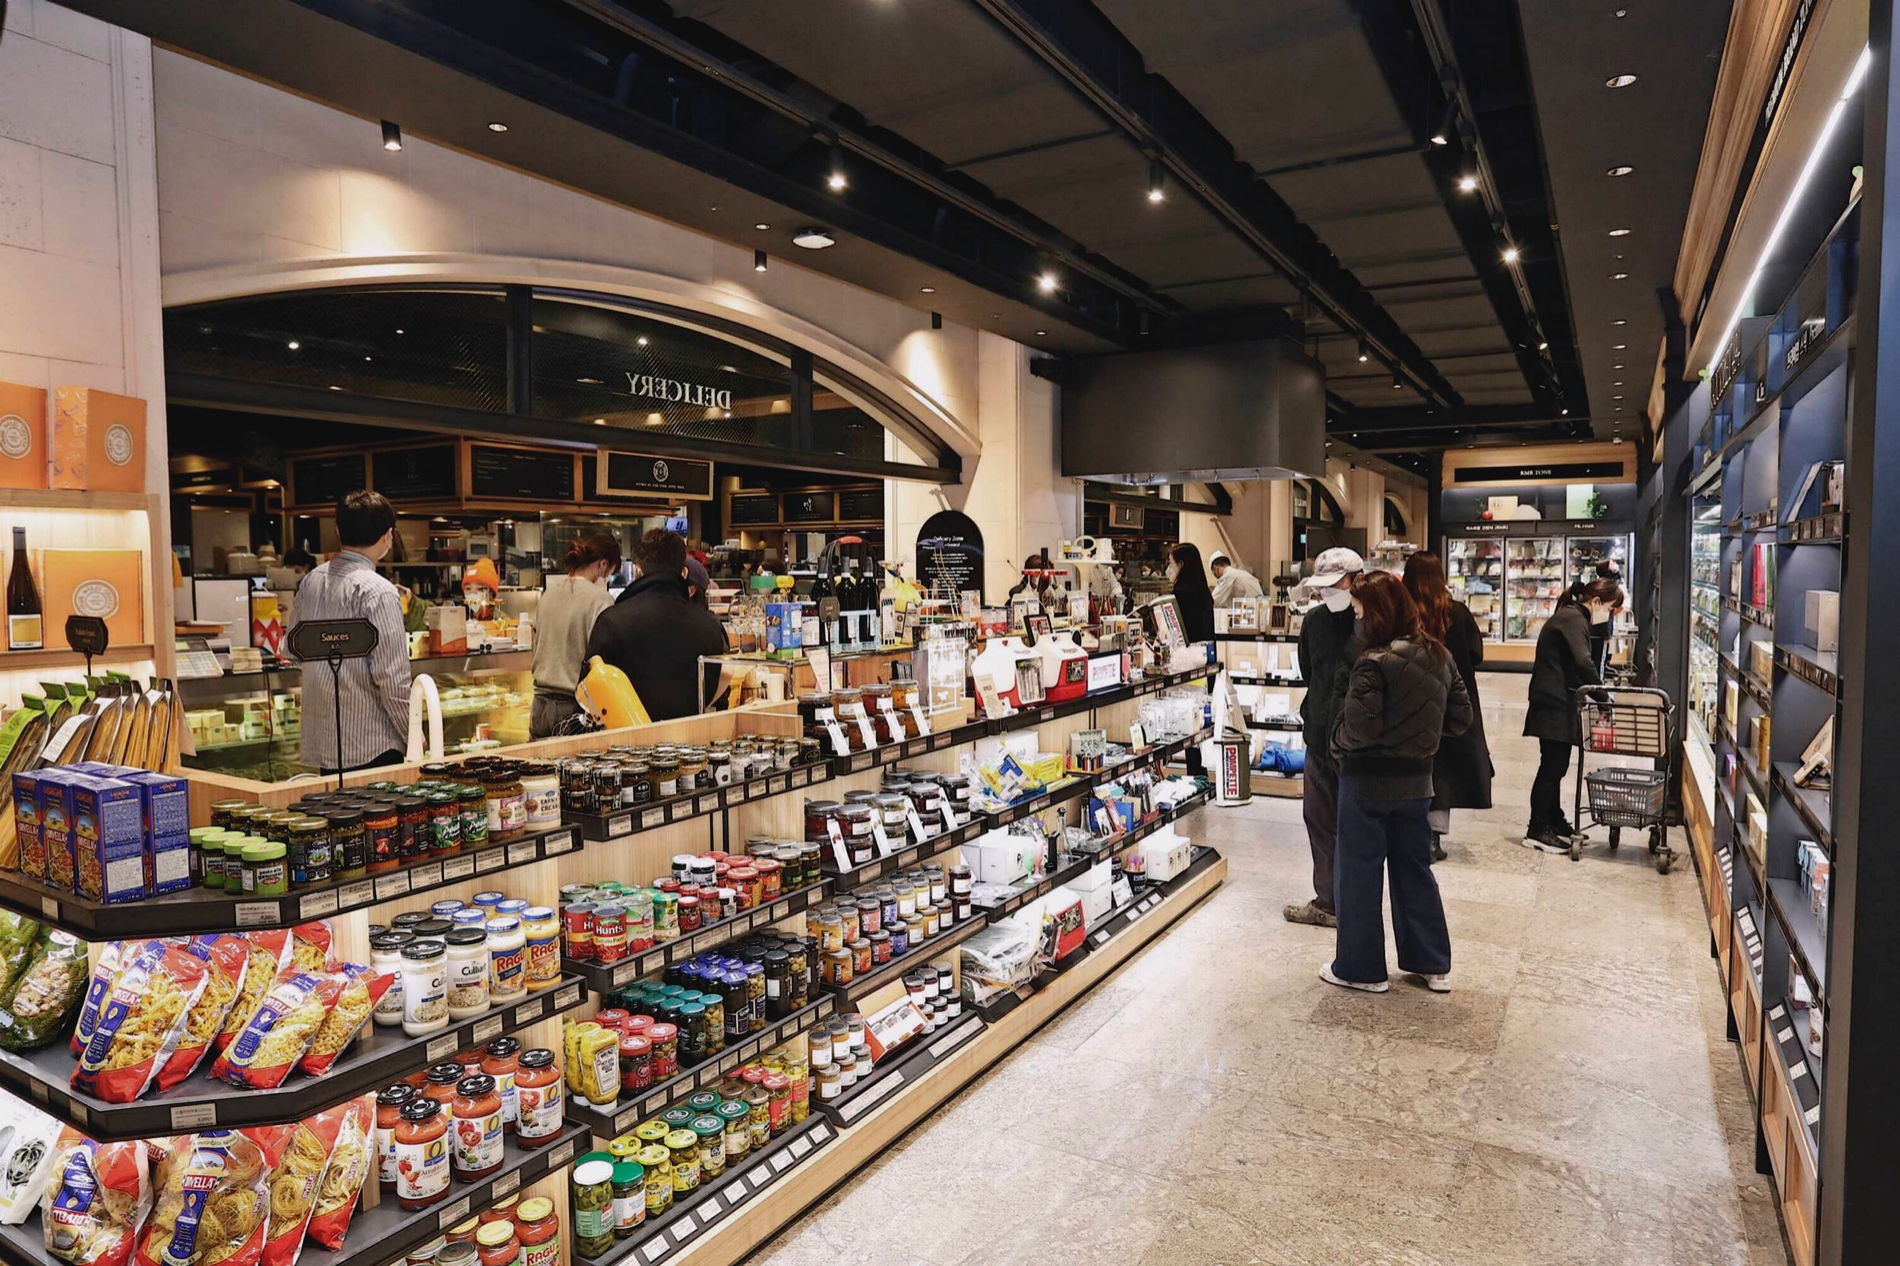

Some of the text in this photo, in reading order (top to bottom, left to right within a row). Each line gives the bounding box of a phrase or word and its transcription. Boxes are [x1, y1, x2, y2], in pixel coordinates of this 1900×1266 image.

[321, 633, 350, 642] Sauces
[1226, 746, 1238, 796] POMPETTE
[184, 1176, 214, 1189] DIVELLA
[526, 1243, 556, 1266] RAGU
